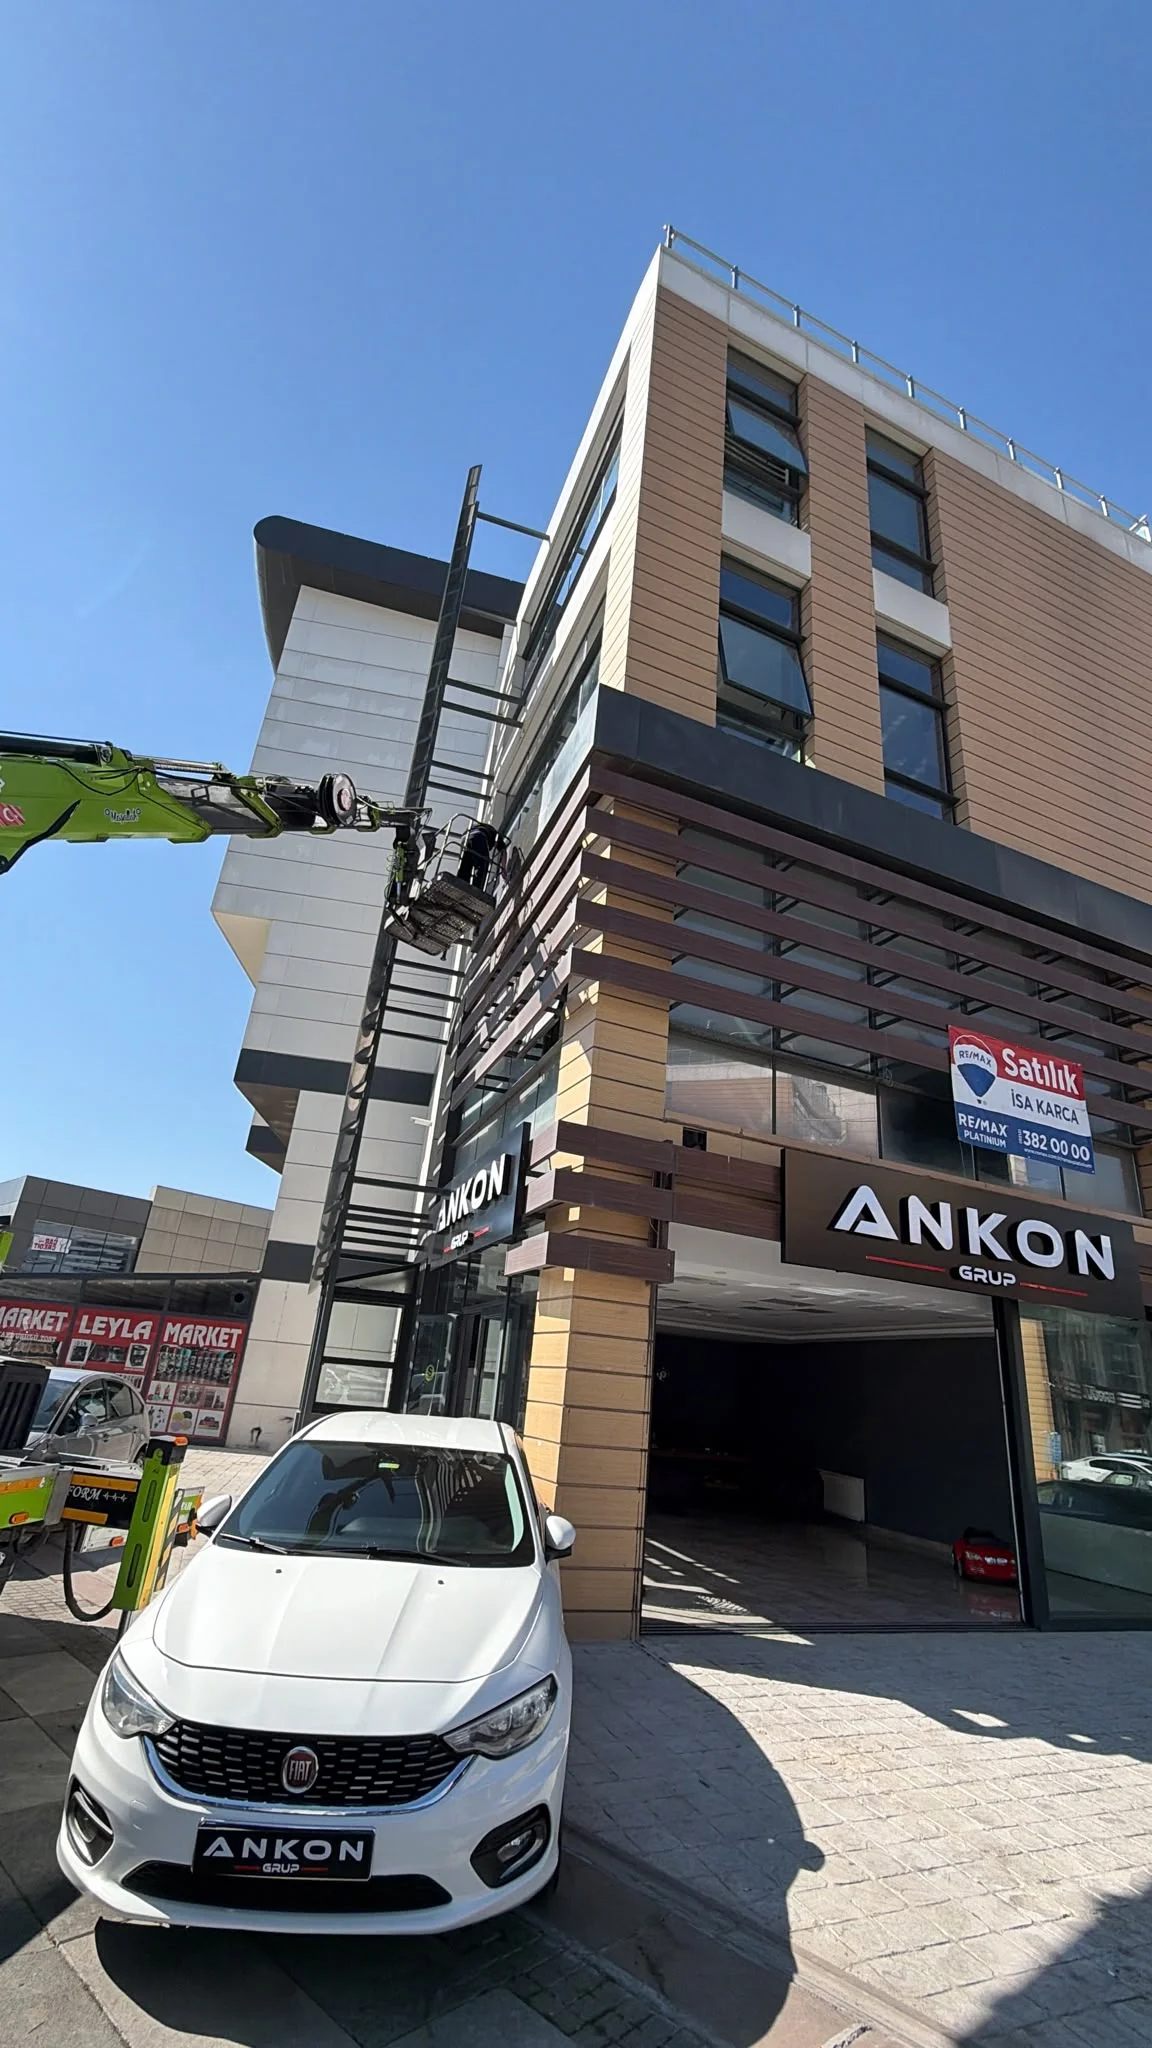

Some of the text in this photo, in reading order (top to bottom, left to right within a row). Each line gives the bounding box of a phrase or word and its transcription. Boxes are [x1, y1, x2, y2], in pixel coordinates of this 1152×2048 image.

[959, 1050, 992, 1068] RE/MAX
[1002, 1048, 1079, 1095] Satılık
[1011, 1089, 1080, 1125] İSA KARCA
[958, 1113, 1008, 1138] RE/MAX
[1023, 1130, 1048, 1151] 382
[1050, 1138, 1069, 1156] 00
[1071, 1144, 1091, 1162] 00
[437, 1153, 506, 1233] ANKON
[834, 1185, 1116, 1280] ANKON
[958, 1265, 1017, 1287] GRUP
[78, 1314, 242, 1349] LEYLA MARKET
[289, 1760, 312, 1781] FIAT
[202, 1836, 364, 1862] ANKON
[262, 1863, 300, 1873] GRUP
